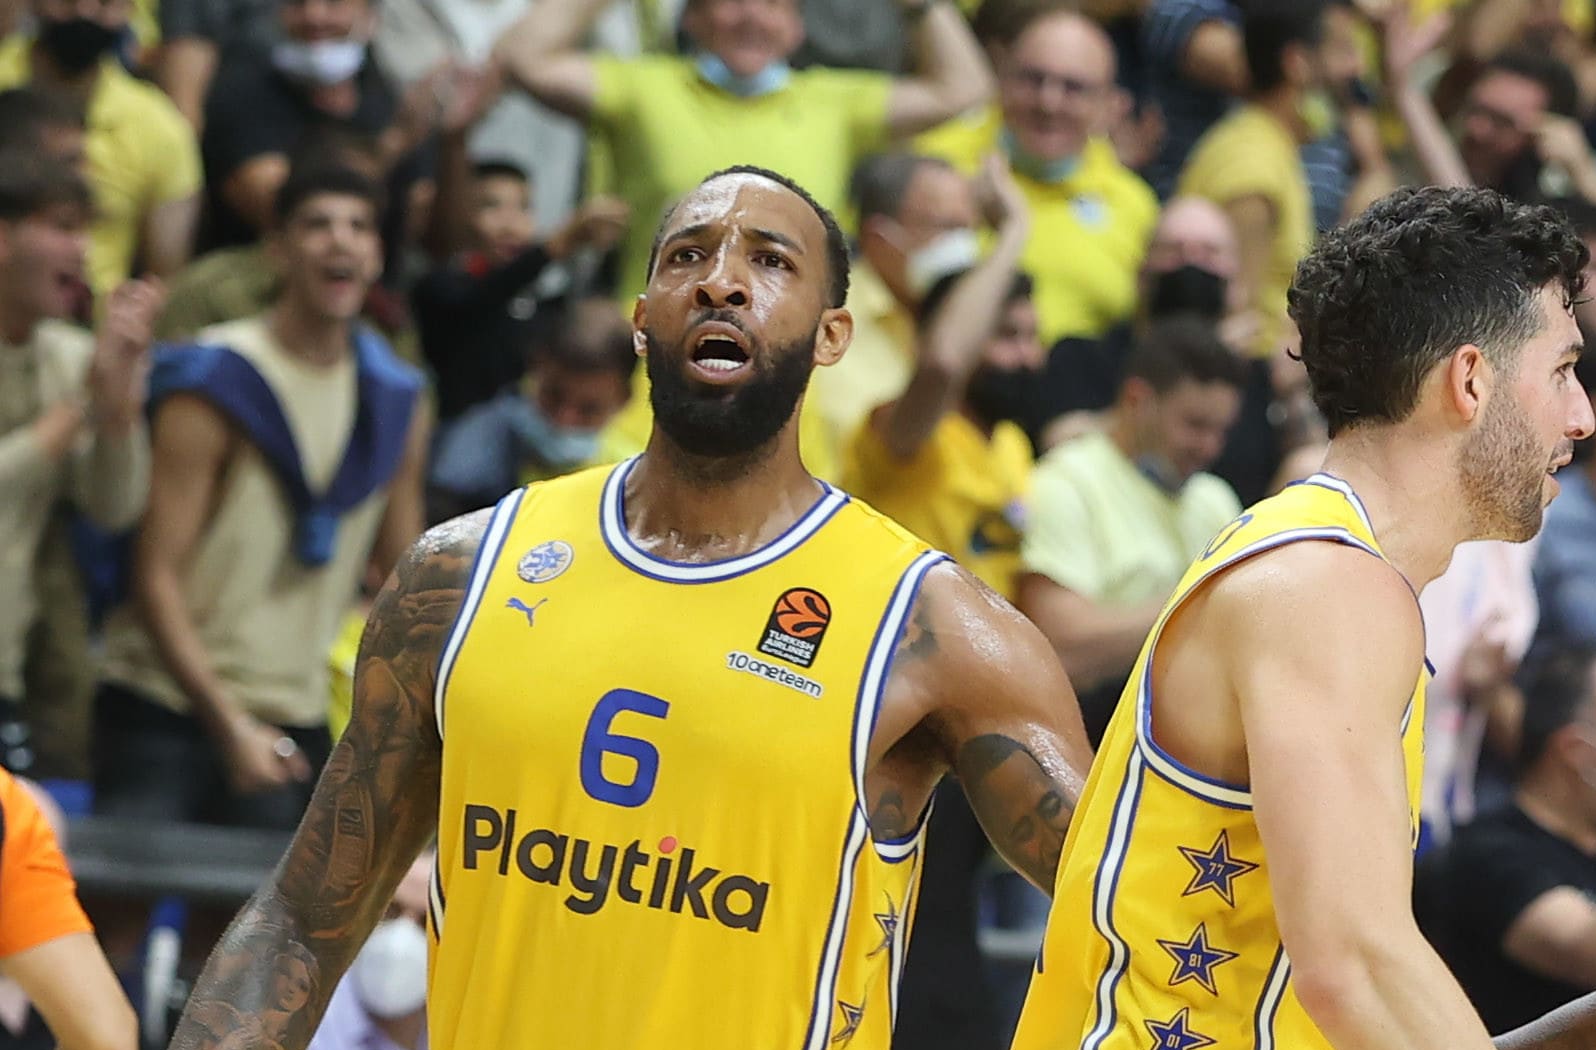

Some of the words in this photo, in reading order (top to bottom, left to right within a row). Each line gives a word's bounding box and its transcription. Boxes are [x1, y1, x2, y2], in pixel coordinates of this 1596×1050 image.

[580, 687, 671, 808] 6
[463, 804, 770, 933] Playtika
[1207, 861, 1225, 877] 77
[1187, 952, 1202, 968] 81
